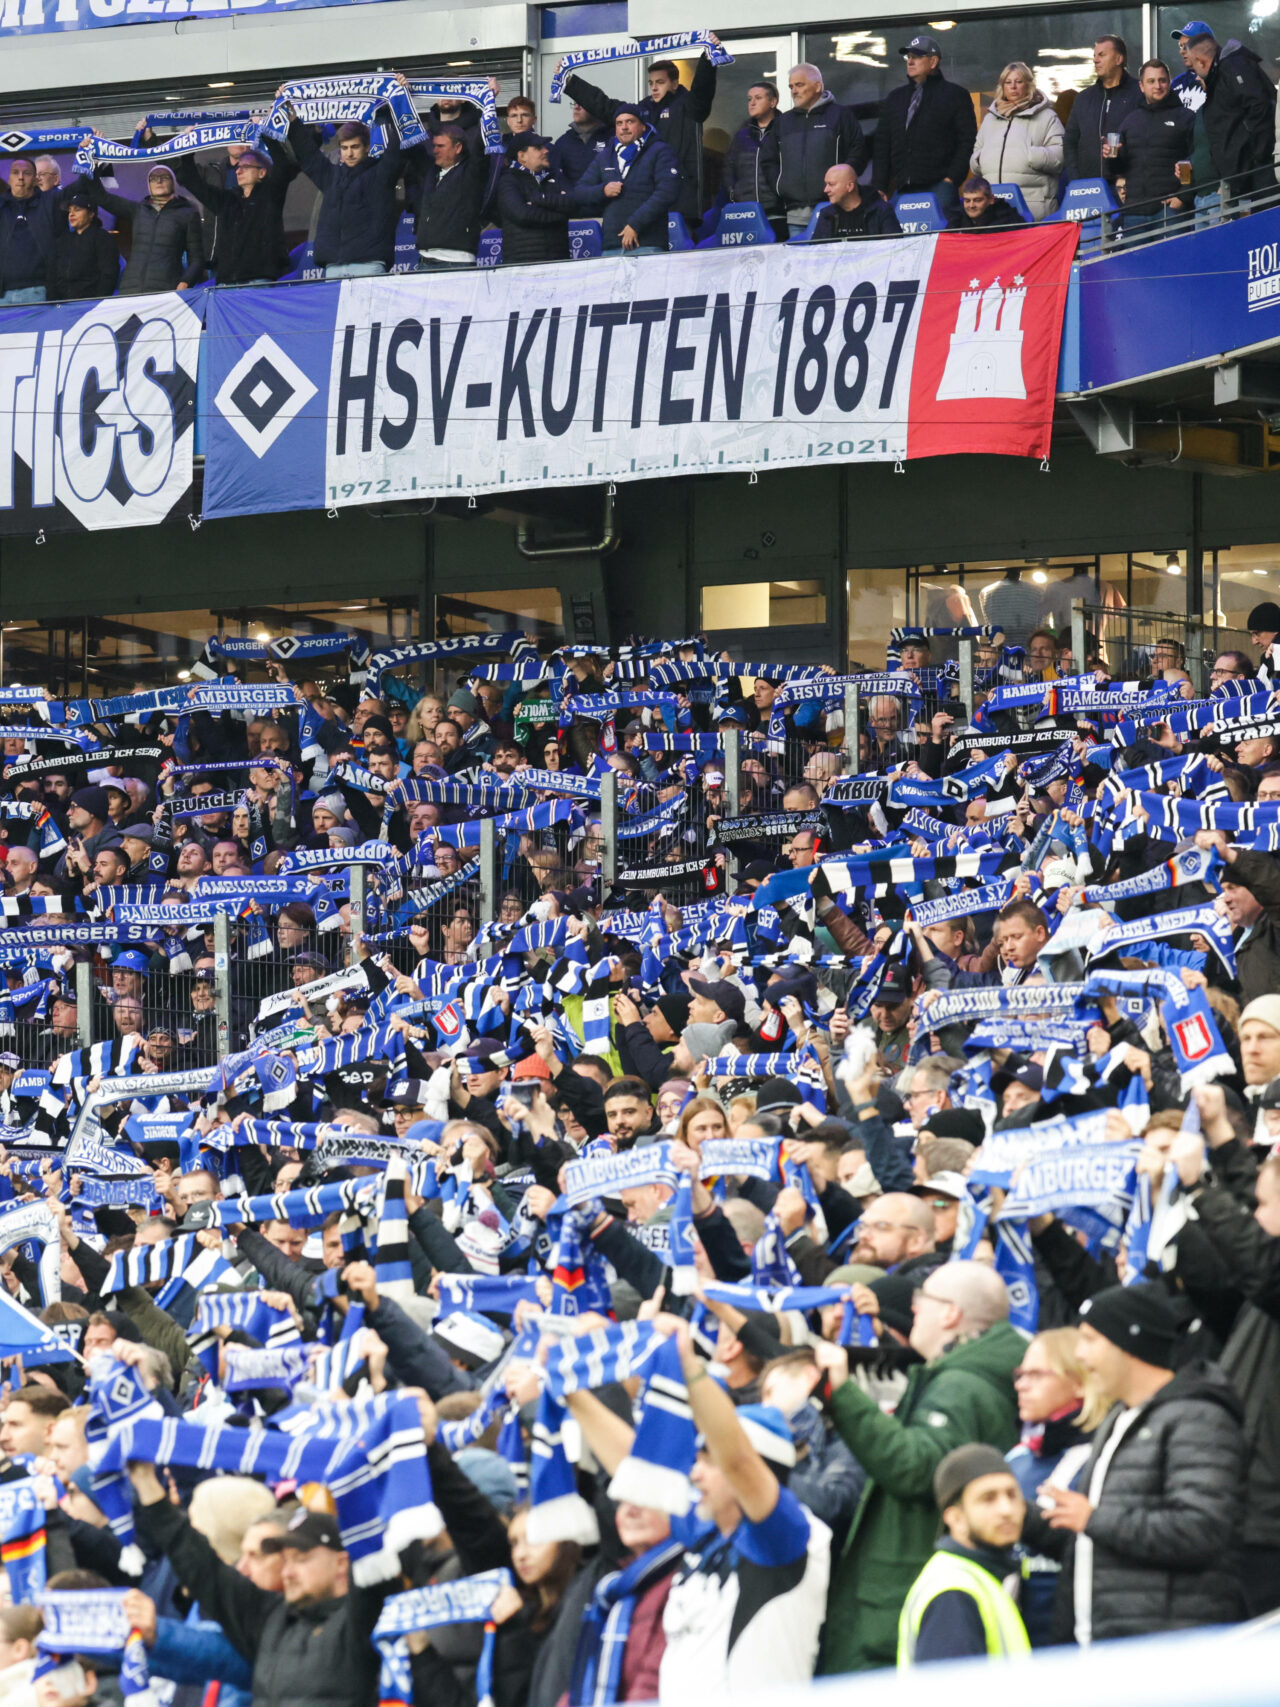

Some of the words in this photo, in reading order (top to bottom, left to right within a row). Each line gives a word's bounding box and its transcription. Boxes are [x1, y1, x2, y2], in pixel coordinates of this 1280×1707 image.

[174, 133, 198, 150] DER
[200, 125, 231, 144] ELBE
[899, 202, 931, 210] RECARO
[725, 211, 756, 220] RECARO
[1066, 208, 1088, 221] HSV
[721, 232, 744, 245] HSV
[302, 268, 323, 280] HSV
[335, 290, 757, 456] HSV-KUTTEN
[772, 280, 920, 418] 1887
[817, 439, 888, 456] 2021
[328, 478, 392, 500] 1972
[366, 633, 504, 684] HAMBURG
[16, 687, 43, 699] CLUB
[793, 683, 825, 699] HSV
[1062, 690, 1148, 706] HAMBURGER
[965, 735, 1012, 750] HAMBURG
[1037, 731, 1051, 741] ICH
[30, 755, 83, 772] HAMBURG
[114, 749, 132, 759] ICH
[135, 746, 162, 758] SEHR
[915, 889, 983, 920] HAMBURGER
[988, 881, 1008, 900] S.V.
[120, 904, 209, 920] HAMBURGER
[128, 926, 157, 940] SV
